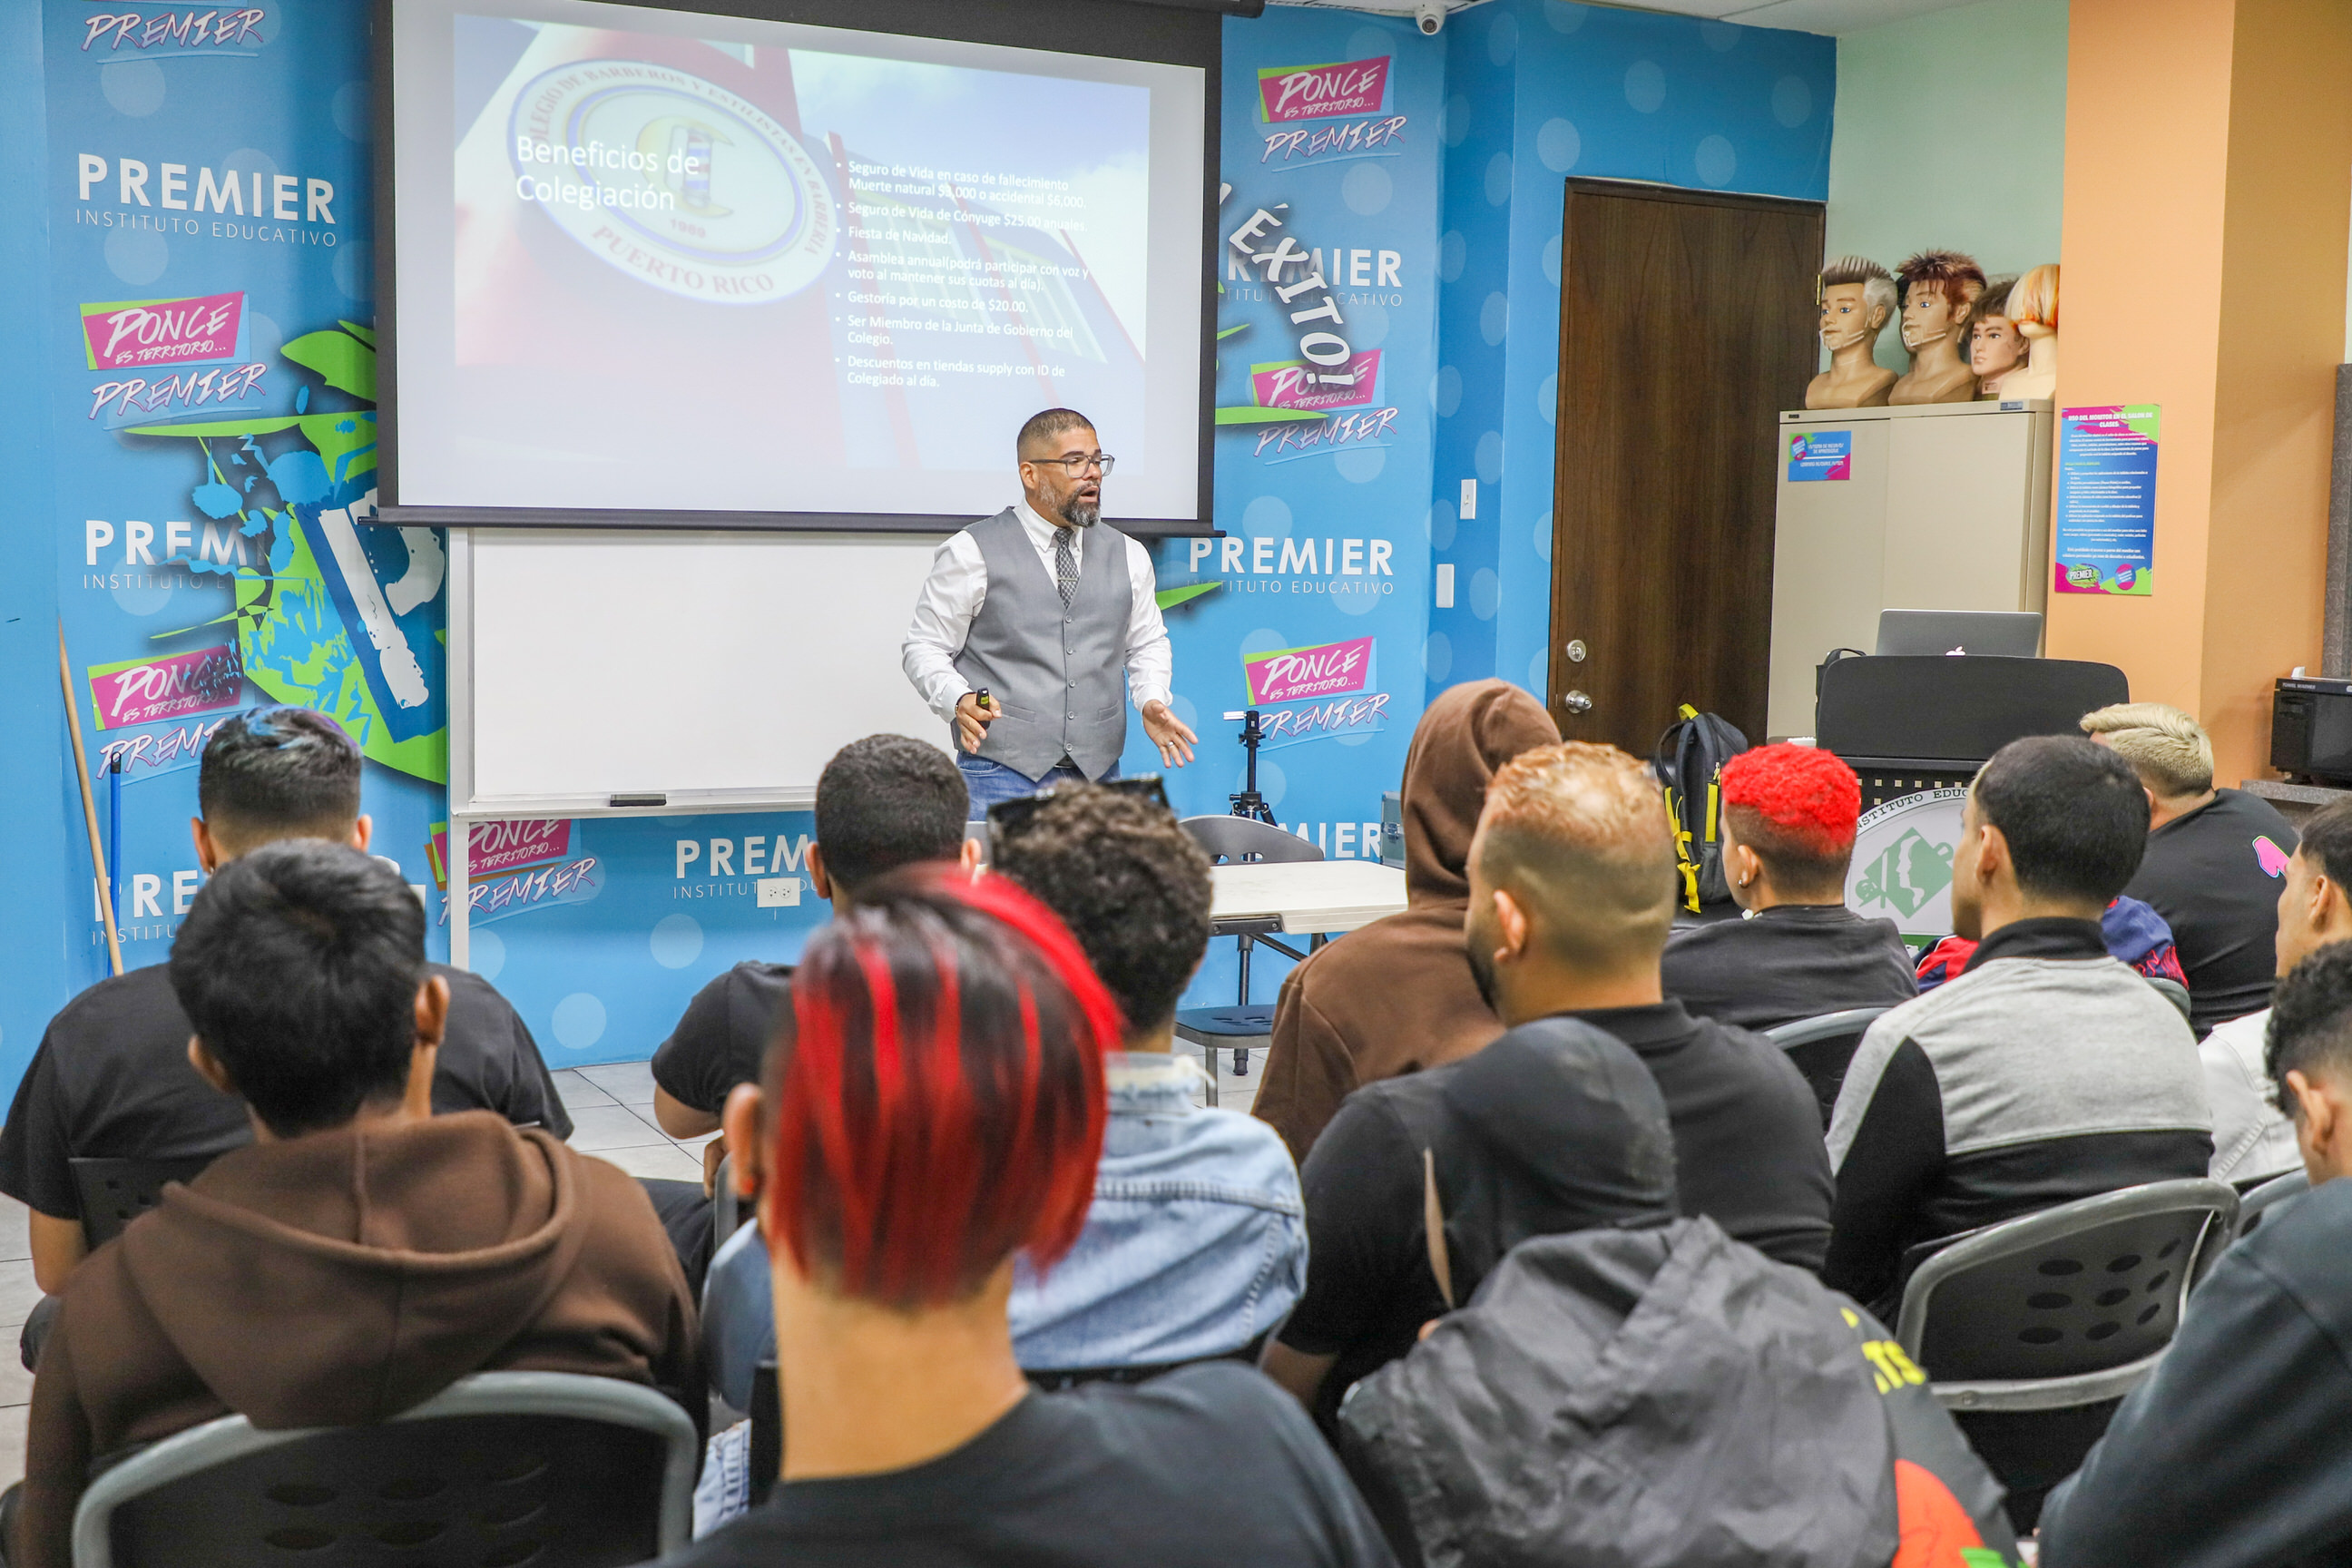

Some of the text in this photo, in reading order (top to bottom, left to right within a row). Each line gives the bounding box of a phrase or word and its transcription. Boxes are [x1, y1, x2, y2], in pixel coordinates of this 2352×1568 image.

[81, 8, 266, 51] PREMIER
[1275, 64, 1381, 113] PONCE
[1284, 108, 1299, 120] ES
[516, 134, 700, 175] Beneficios de
[1260, 115, 1407, 164] PREMIER
[78, 153, 336, 224] PREMIER
[848, 161, 1069, 191] Seguro de Vida en caso de fallecimiento
[848, 177, 892, 193] Muerte
[895, 181, 936, 197] natural
[979, 190, 986, 200] o
[989, 191, 1044, 205] accidental
[515, 173, 675, 211] Colegiación
[76, 209, 337, 248] INSTITUTO EDUCATIVO
[848, 201, 889, 218] Seguro
[891, 204, 906, 218] de
[908, 205, 934, 220] Vida
[936, 208, 951, 221] de
[954, 210, 1001, 227] Cónyuge
[1004, 212, 1041, 228] $25.00
[848, 226, 952, 245] Fiesta de Navidad.
[591, 224, 775, 295] PUERTO RICO
[848, 250, 905, 265] Asamblea
[985, 260, 1037, 276] participar
[1040, 265, 1060, 277] con
[1062, 267, 1080, 278] voz
[1082, 268, 1089, 280] y
[848, 268, 1044, 293] voto al mantener sus cuotas al día).
[848, 289, 1029, 313] Gestoría por un costo de $20.00.
[103, 301, 233, 358] PONCE
[848, 314, 1073, 339] Ser Miembro de la Junta de Gobierno del
[848, 330, 894, 347] Colegio.
[115, 351, 133, 366] ES
[848, 355, 1066, 377] Descuentos en tiendas supply con ID de
[89, 363, 268, 419] PREMIER
[848, 371, 940, 388] Colegiado al día.
[1254, 407, 1399, 457] PREMIER
[1189, 536, 1395, 576] PREMIER
[83, 573, 204, 590] INSTITUTO
[1291, 580, 1394, 595] EDUCATIVO
[1260, 644, 1365, 695] PONCE
[1269, 689, 1284, 701] ES
[122, 708, 141, 723] ES
[1857, 793, 1924, 828] NSTITUTO
